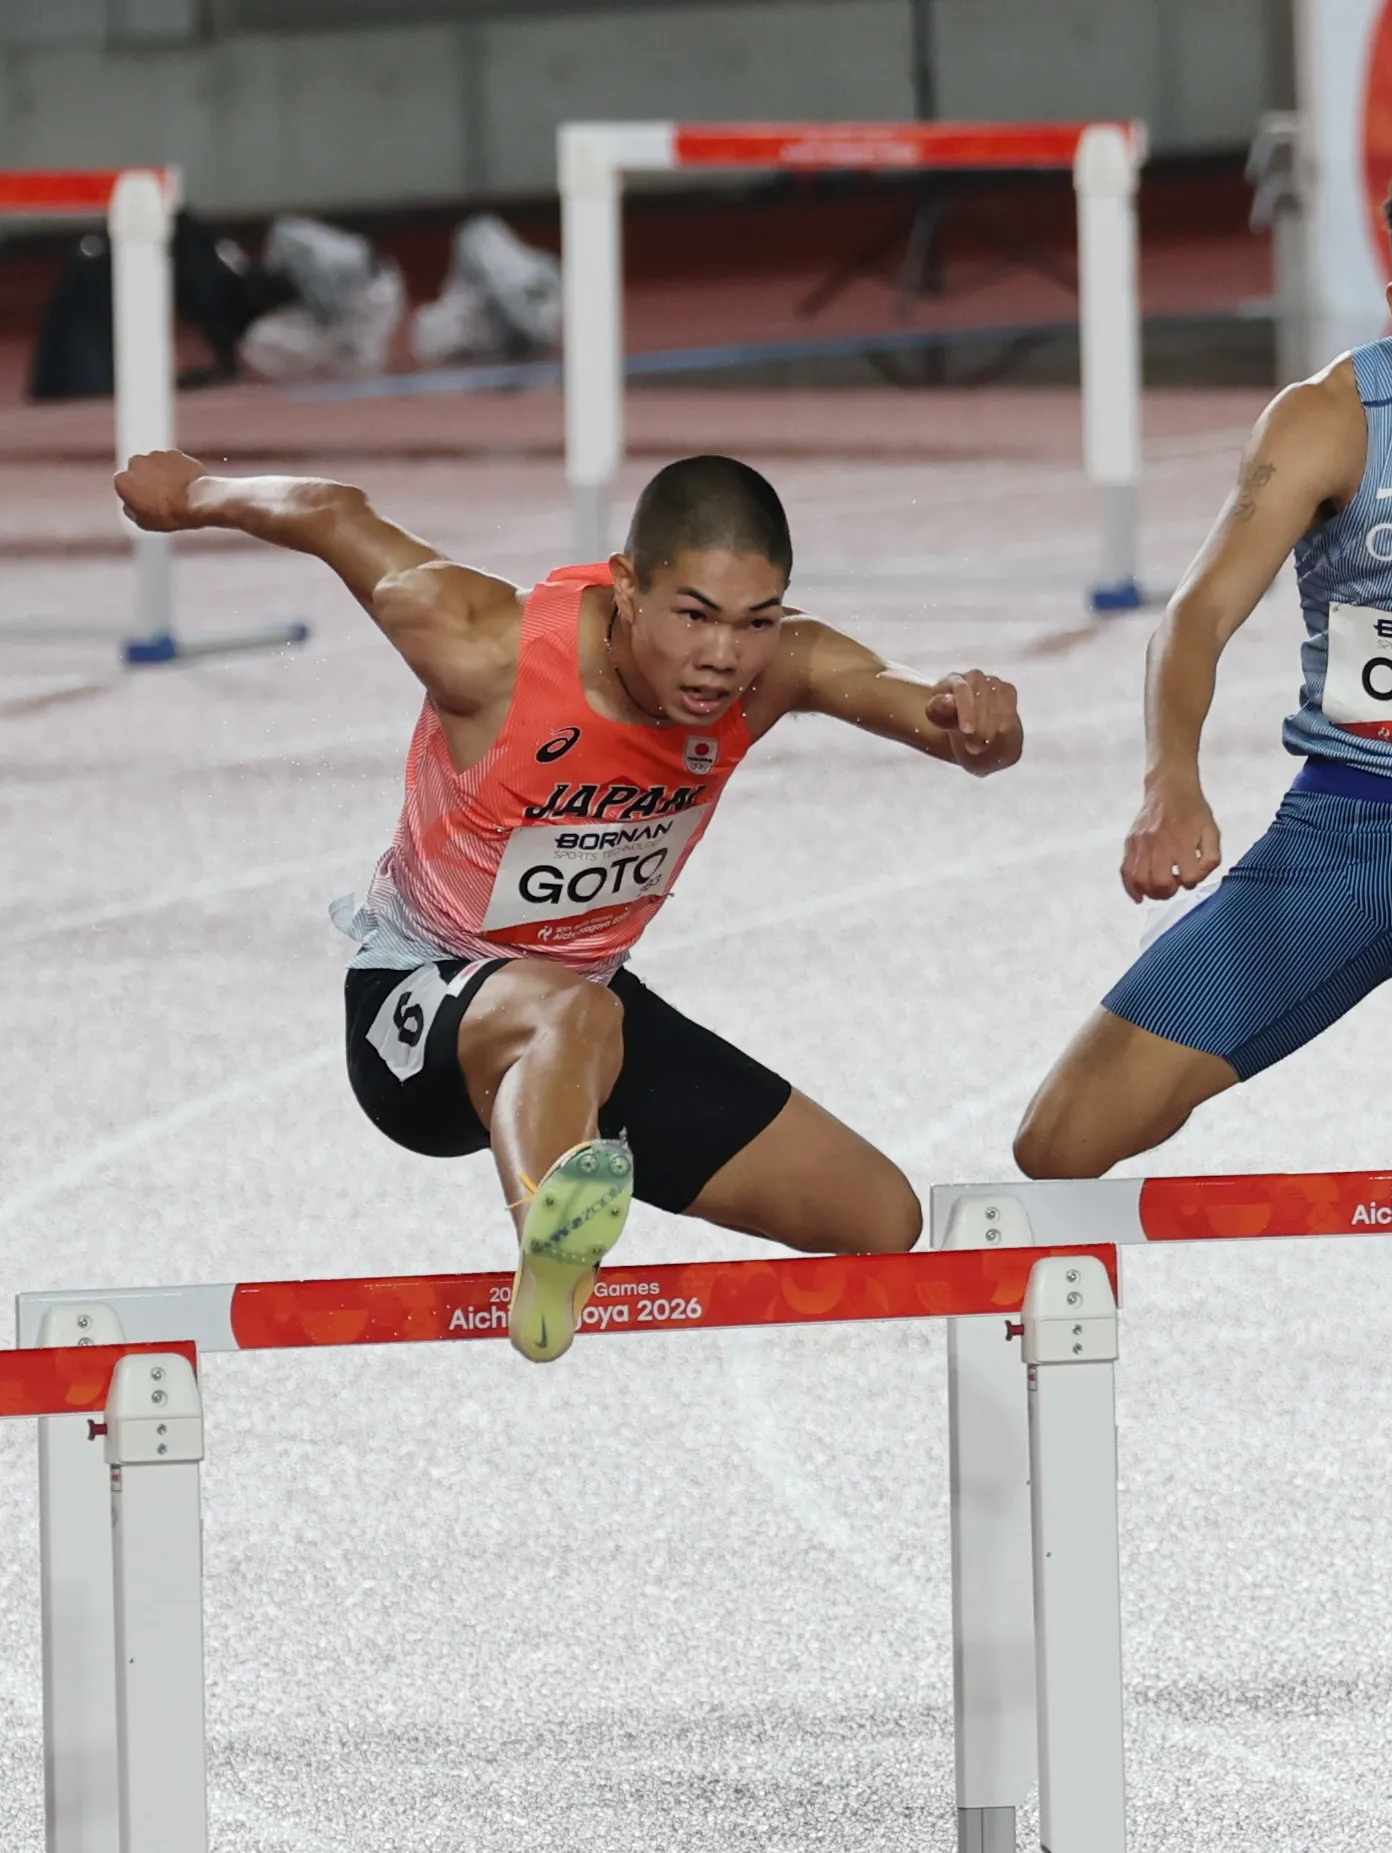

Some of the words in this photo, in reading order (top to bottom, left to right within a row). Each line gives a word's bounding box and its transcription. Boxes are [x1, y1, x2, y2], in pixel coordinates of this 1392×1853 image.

[523, 783, 707, 820] JAPAN
[554, 820, 674, 850] BORNAN
[518, 847, 668, 904] GOTO
[393, 991, 424, 1047] 6
[489, 1286, 513, 1303] 20
[594, 1282, 660, 1298] Games
[636, 1297, 702, 1322] 2026
